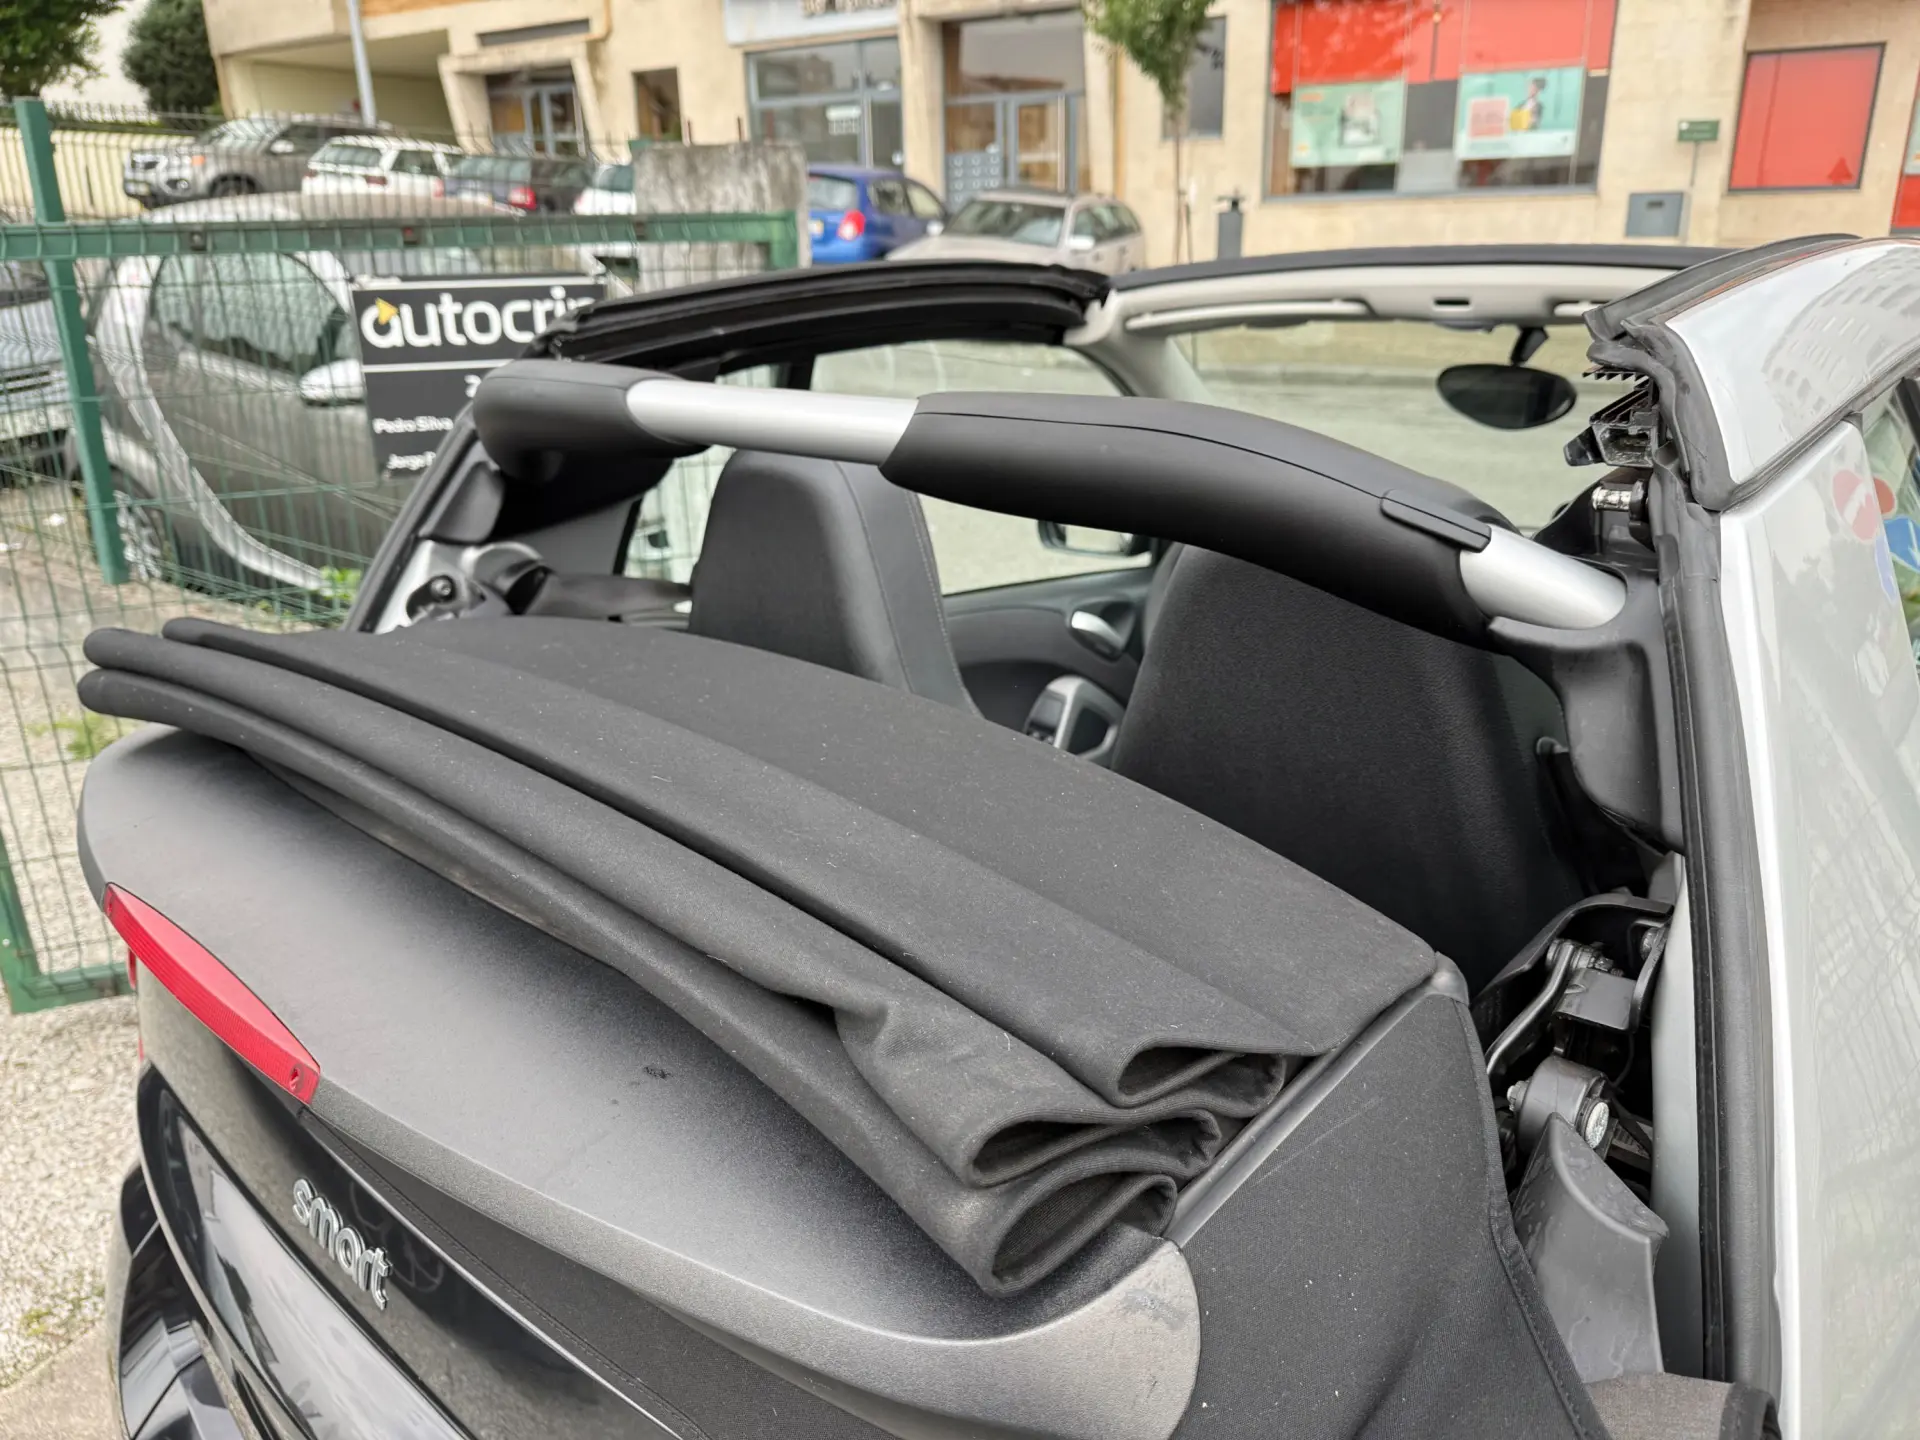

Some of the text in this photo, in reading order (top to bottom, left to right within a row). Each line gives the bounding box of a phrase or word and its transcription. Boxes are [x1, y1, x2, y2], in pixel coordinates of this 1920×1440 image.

[372, 415, 454, 434] Pedro Silva
[386, 453, 425, 471] Jorge
[292, 1175, 392, 1310] smart
